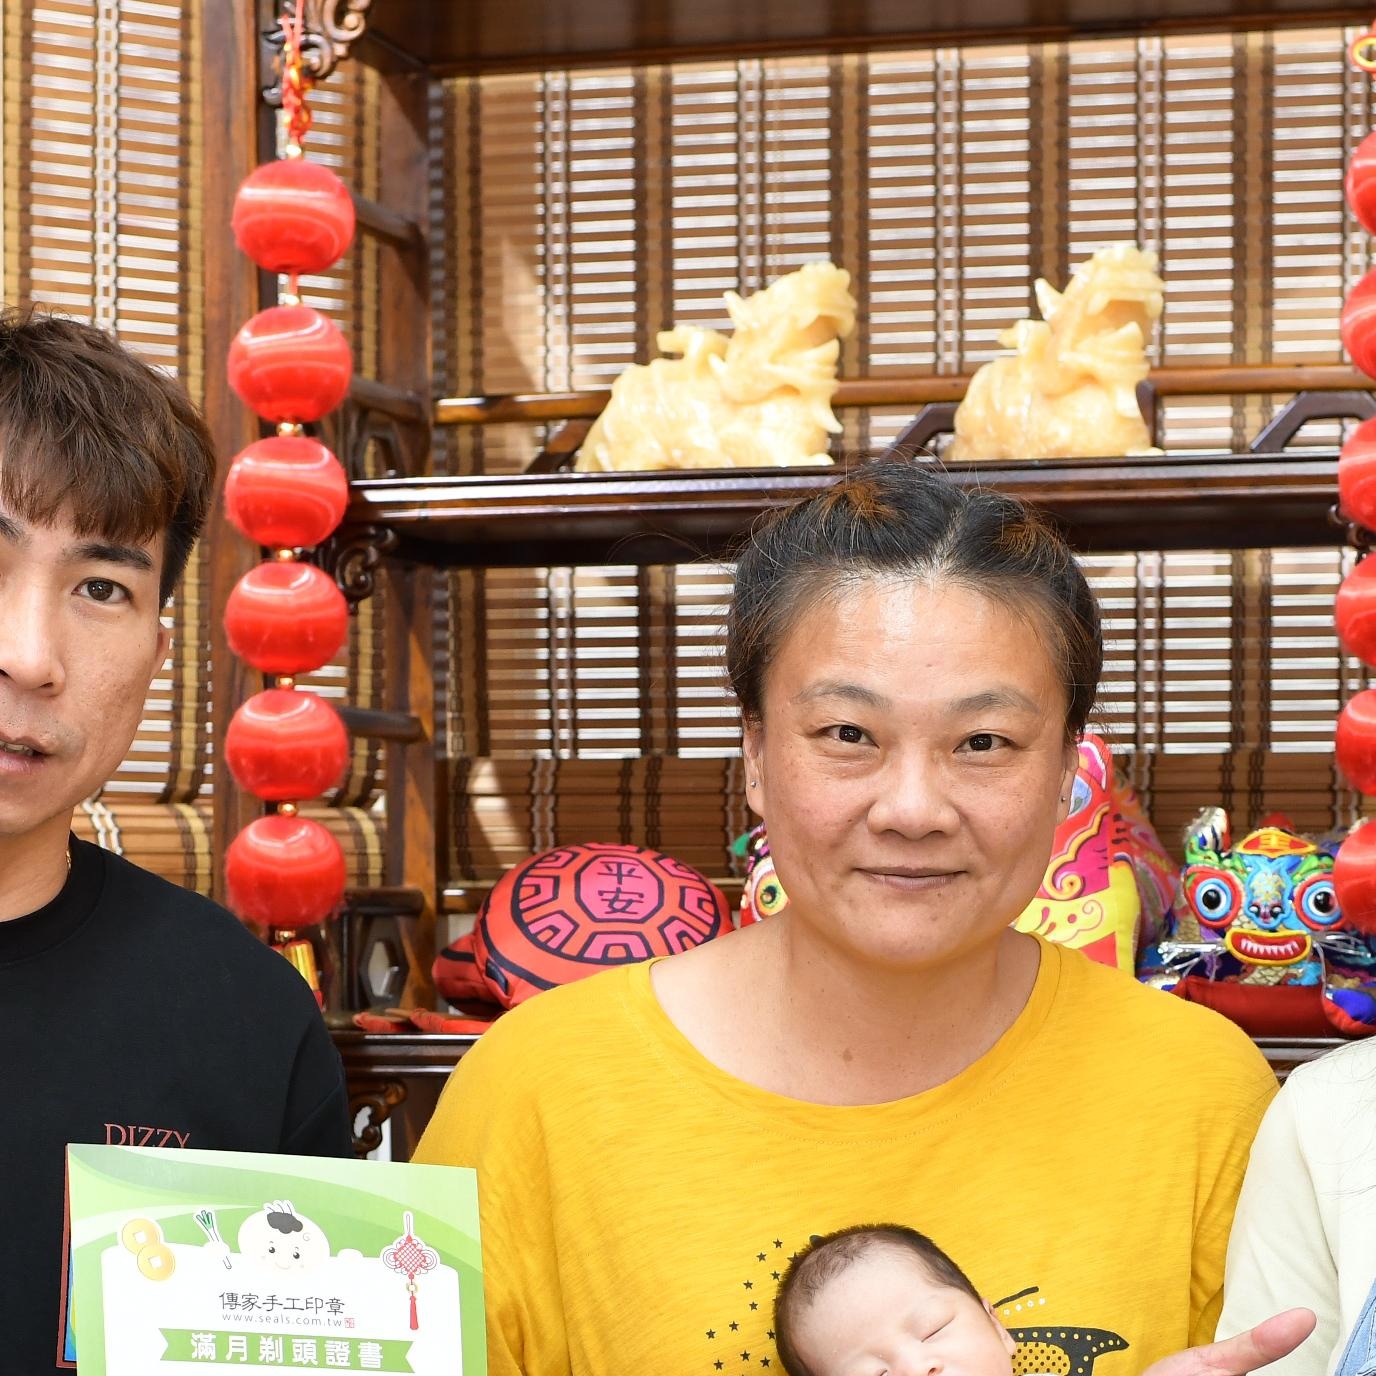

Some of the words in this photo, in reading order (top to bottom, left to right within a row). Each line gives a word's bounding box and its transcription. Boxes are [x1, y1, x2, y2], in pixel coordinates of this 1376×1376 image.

[596, 860, 644, 915] 平安
[104, 1122, 191, 1149] DIZZY
[219, 1291, 345, 1316] 傳家手工印章
[222, 1312, 343, 1328] www.seals.com.tw
[190, 1331, 384, 1369] 滿月剃頭證書
